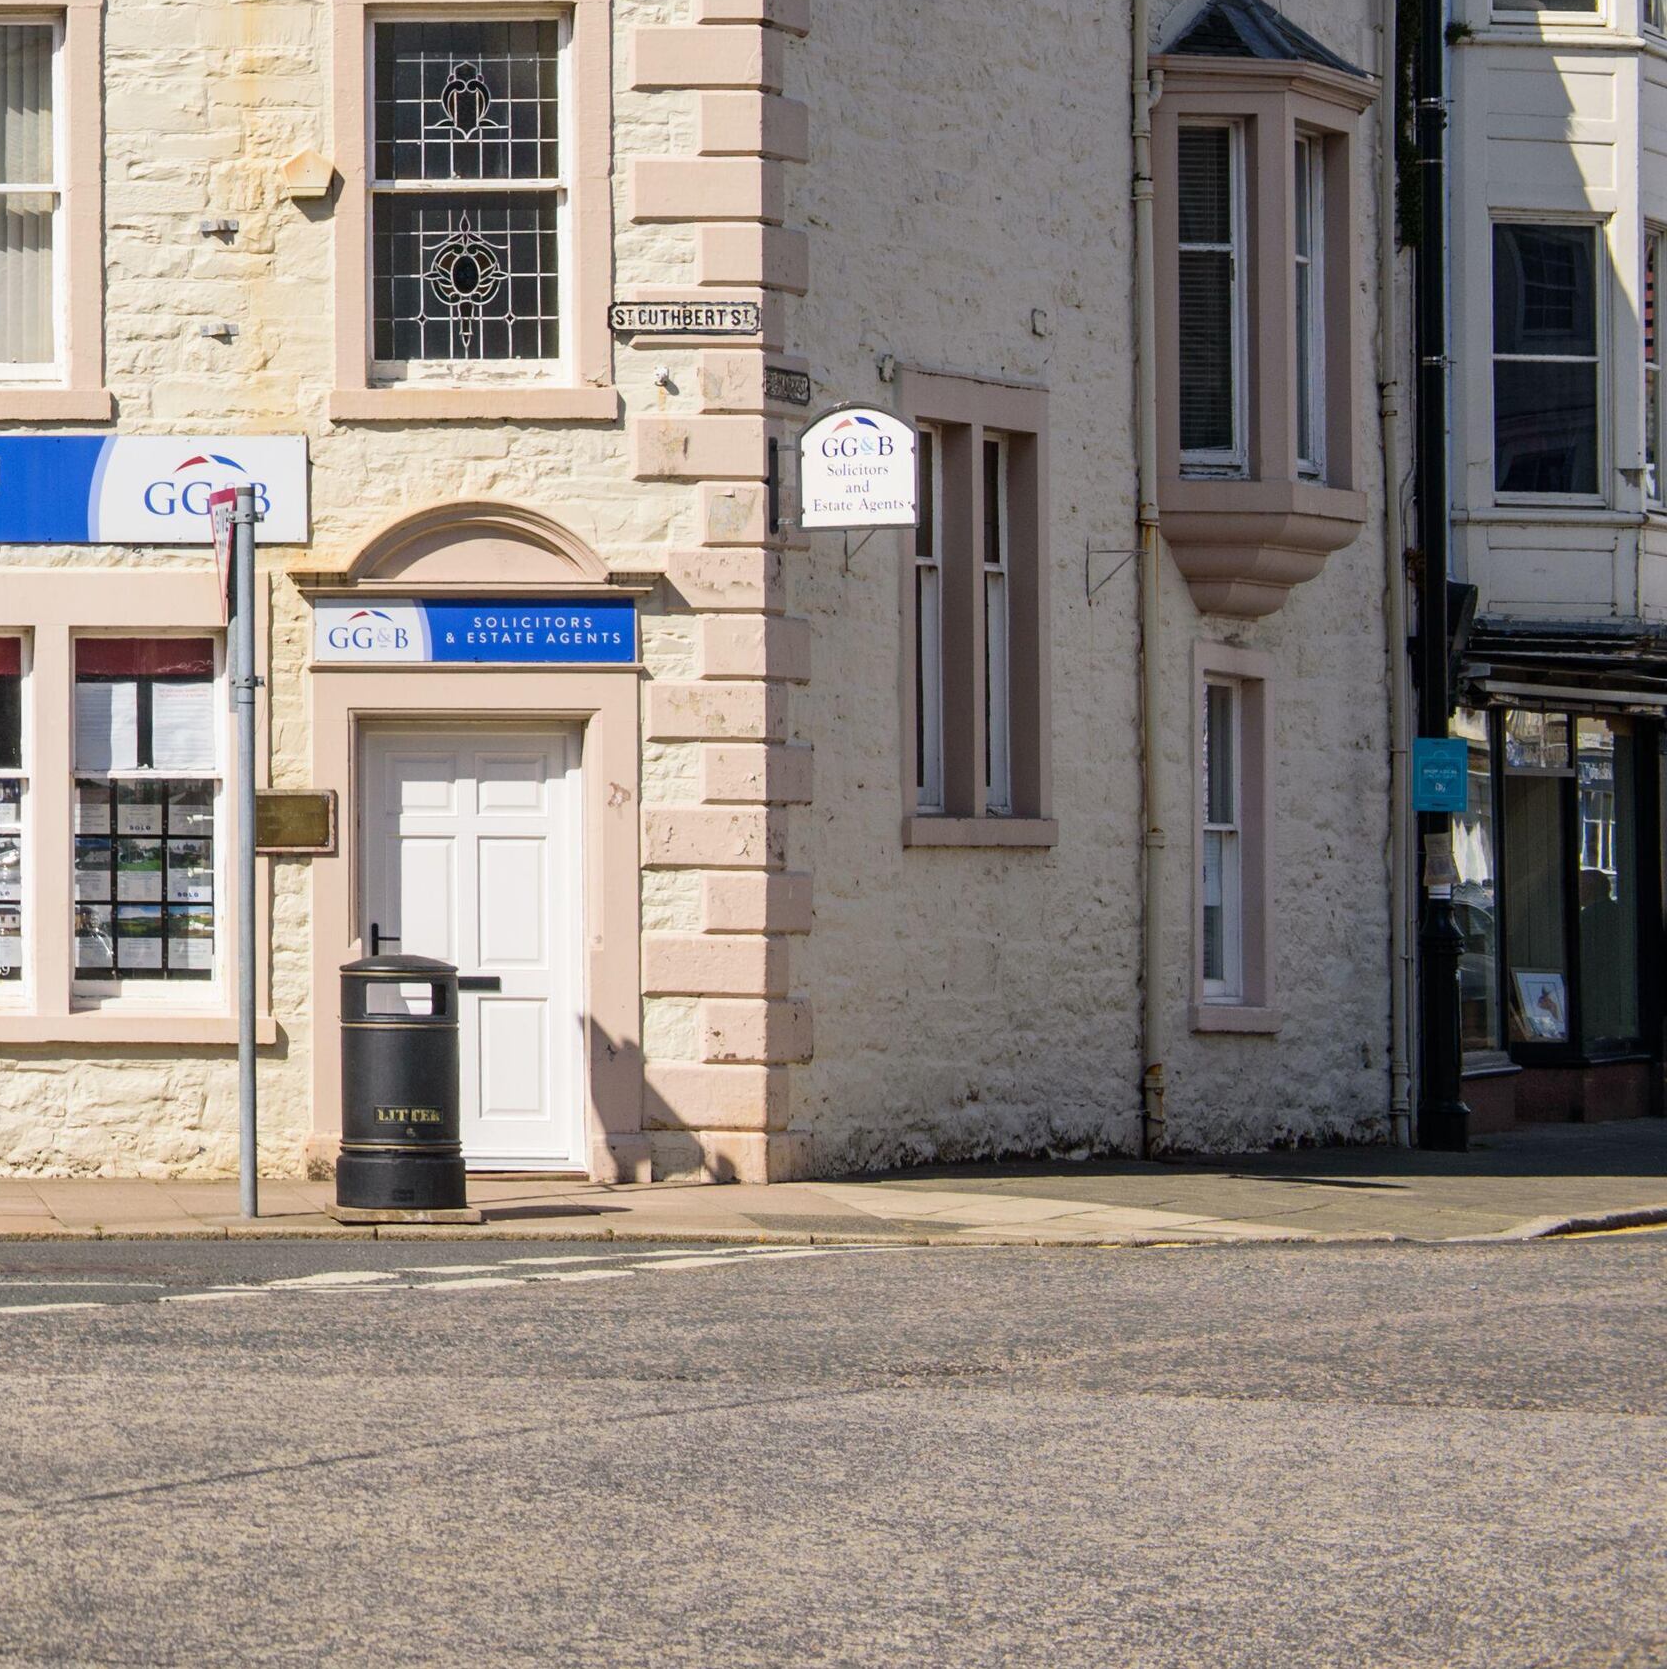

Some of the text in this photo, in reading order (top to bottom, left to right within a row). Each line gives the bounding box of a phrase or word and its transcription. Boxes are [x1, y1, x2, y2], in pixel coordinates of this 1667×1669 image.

[638, 309, 726, 326] CUTHBERT
[827, 463, 889, 476] Solicitors
[845, 480, 870, 493] and
[143, 481, 271, 516] GGB
[813, 497, 905, 512] Estate Agents
[473, 616, 593, 629] SOLICITORS
[445, 632, 622, 644] & ESTATE AGENTS
[377, 1108, 440, 1122] LITTER
